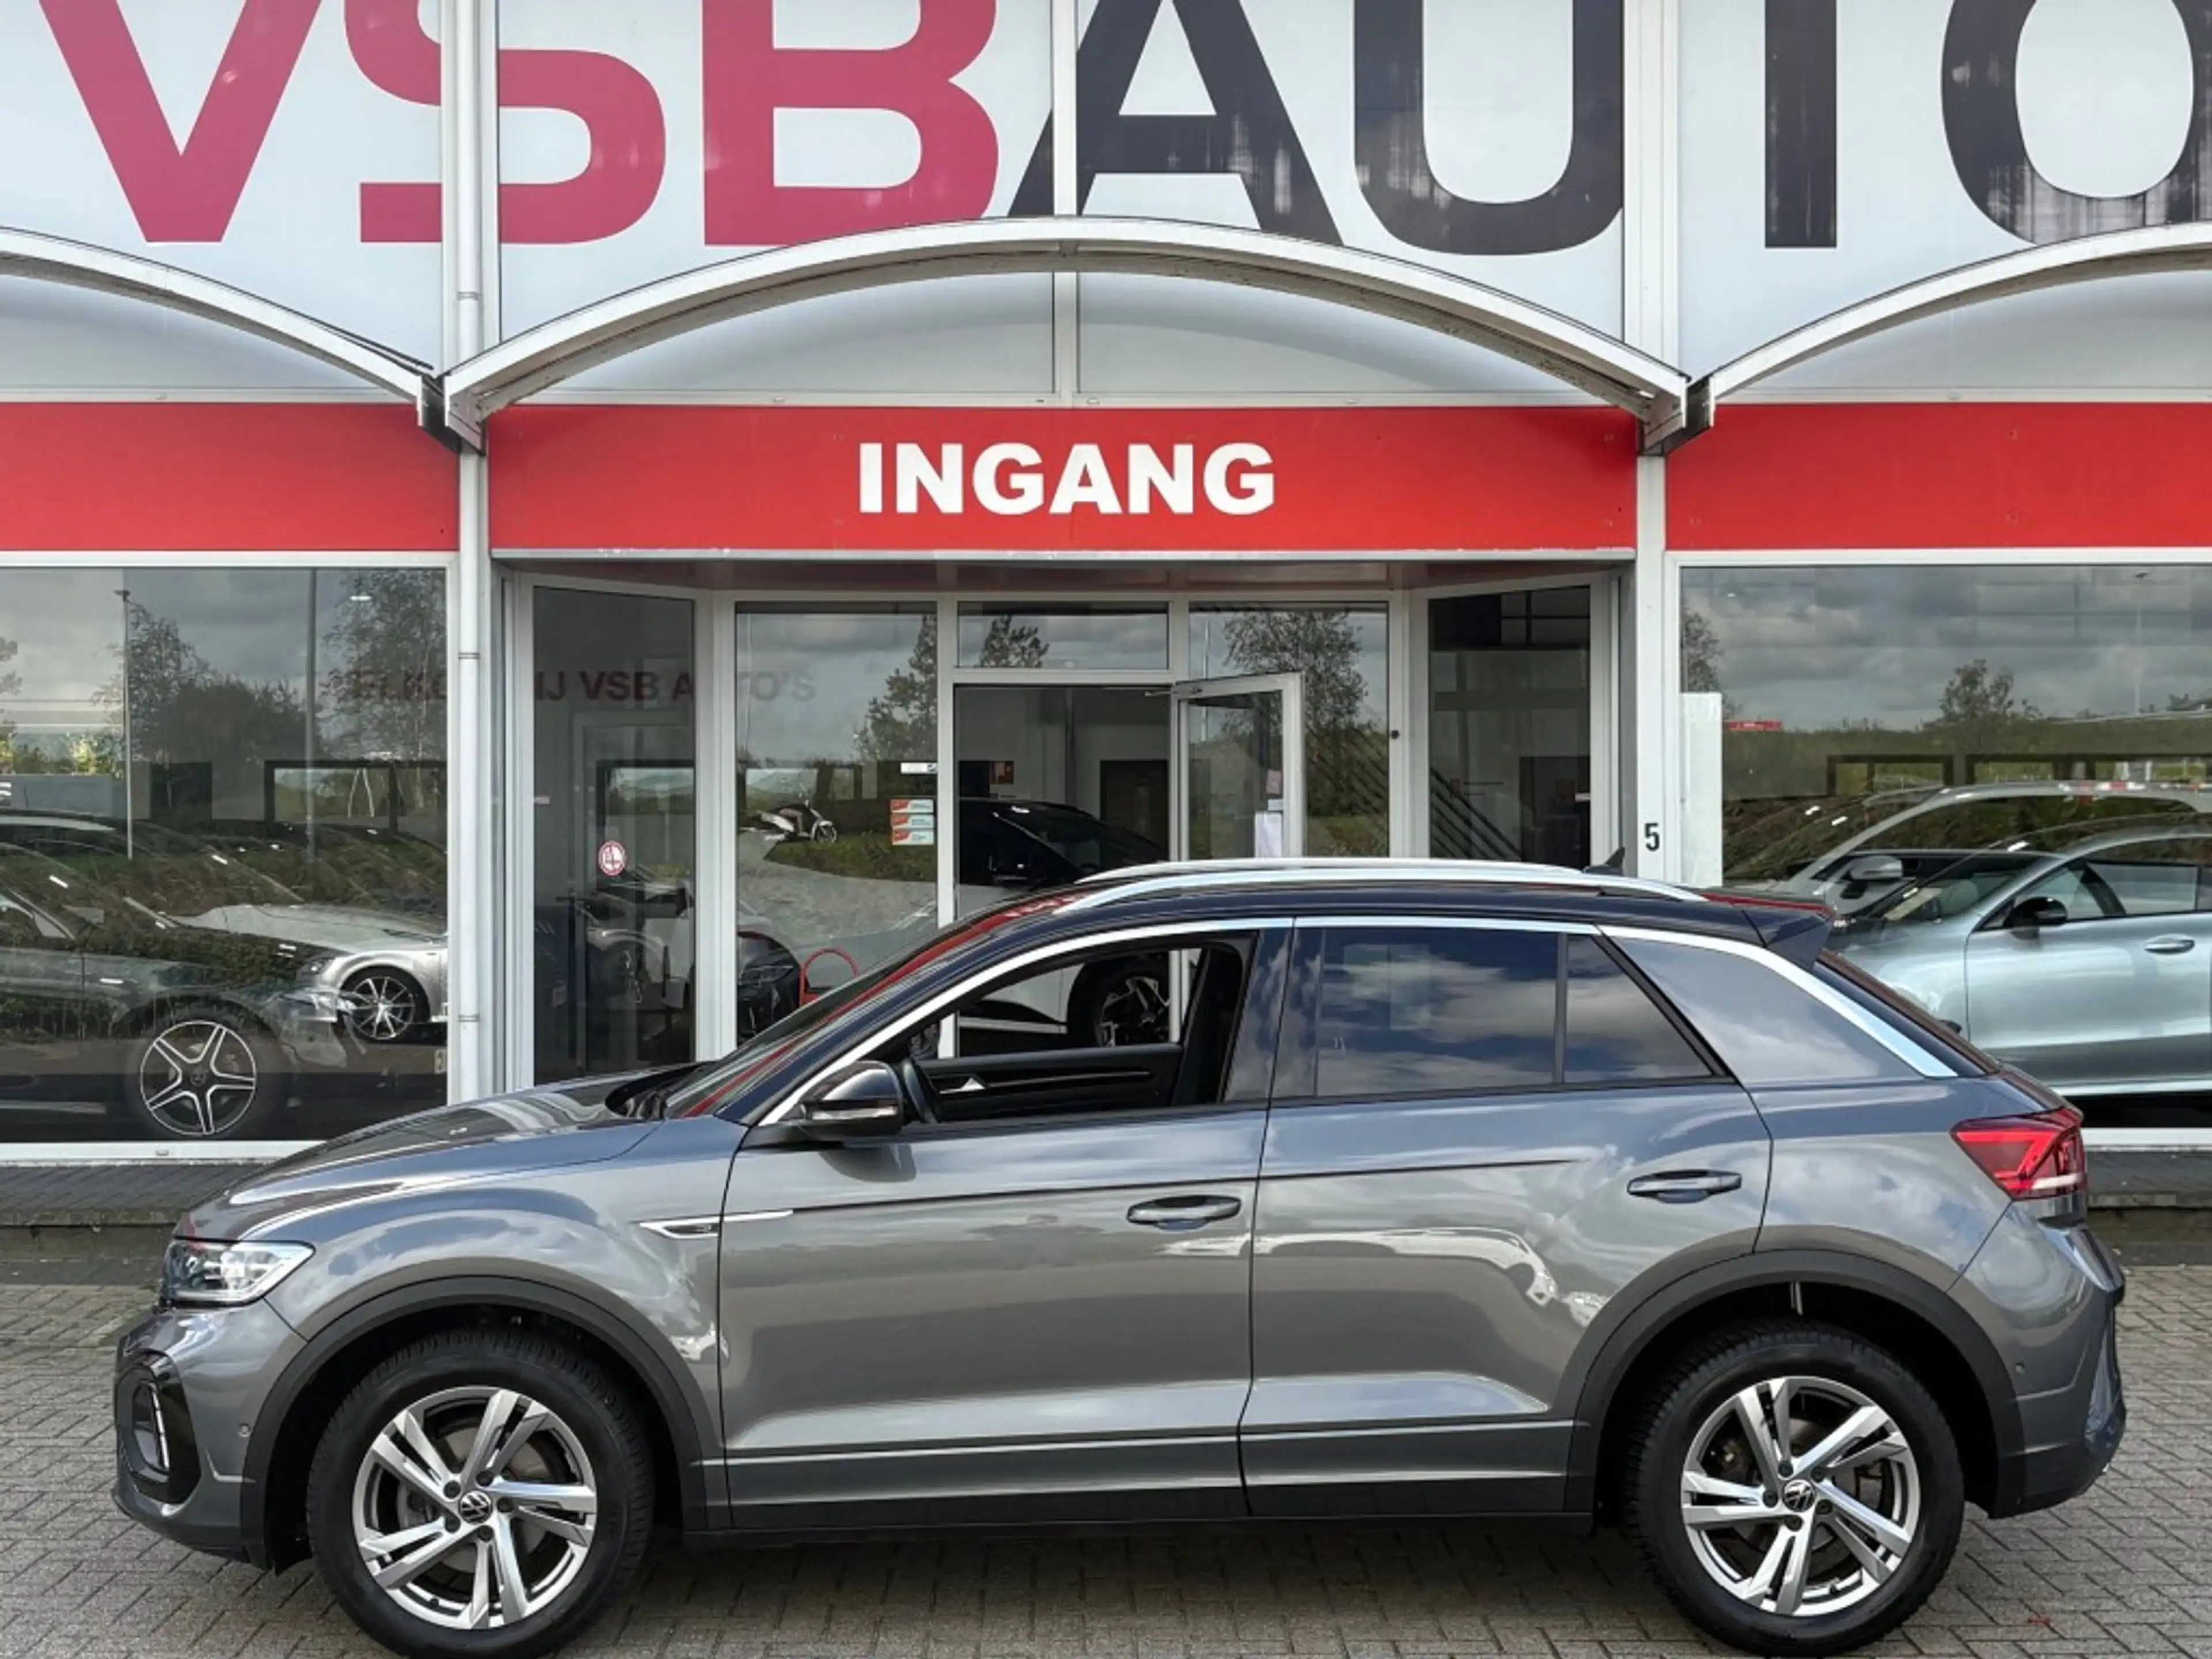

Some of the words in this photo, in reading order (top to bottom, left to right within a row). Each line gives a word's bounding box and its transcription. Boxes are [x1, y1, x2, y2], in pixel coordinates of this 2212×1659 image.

[859, 442, 1275, 516] INGANG
[578, 671, 660, 701] VSB
[1645, 823, 1660, 851] 5
